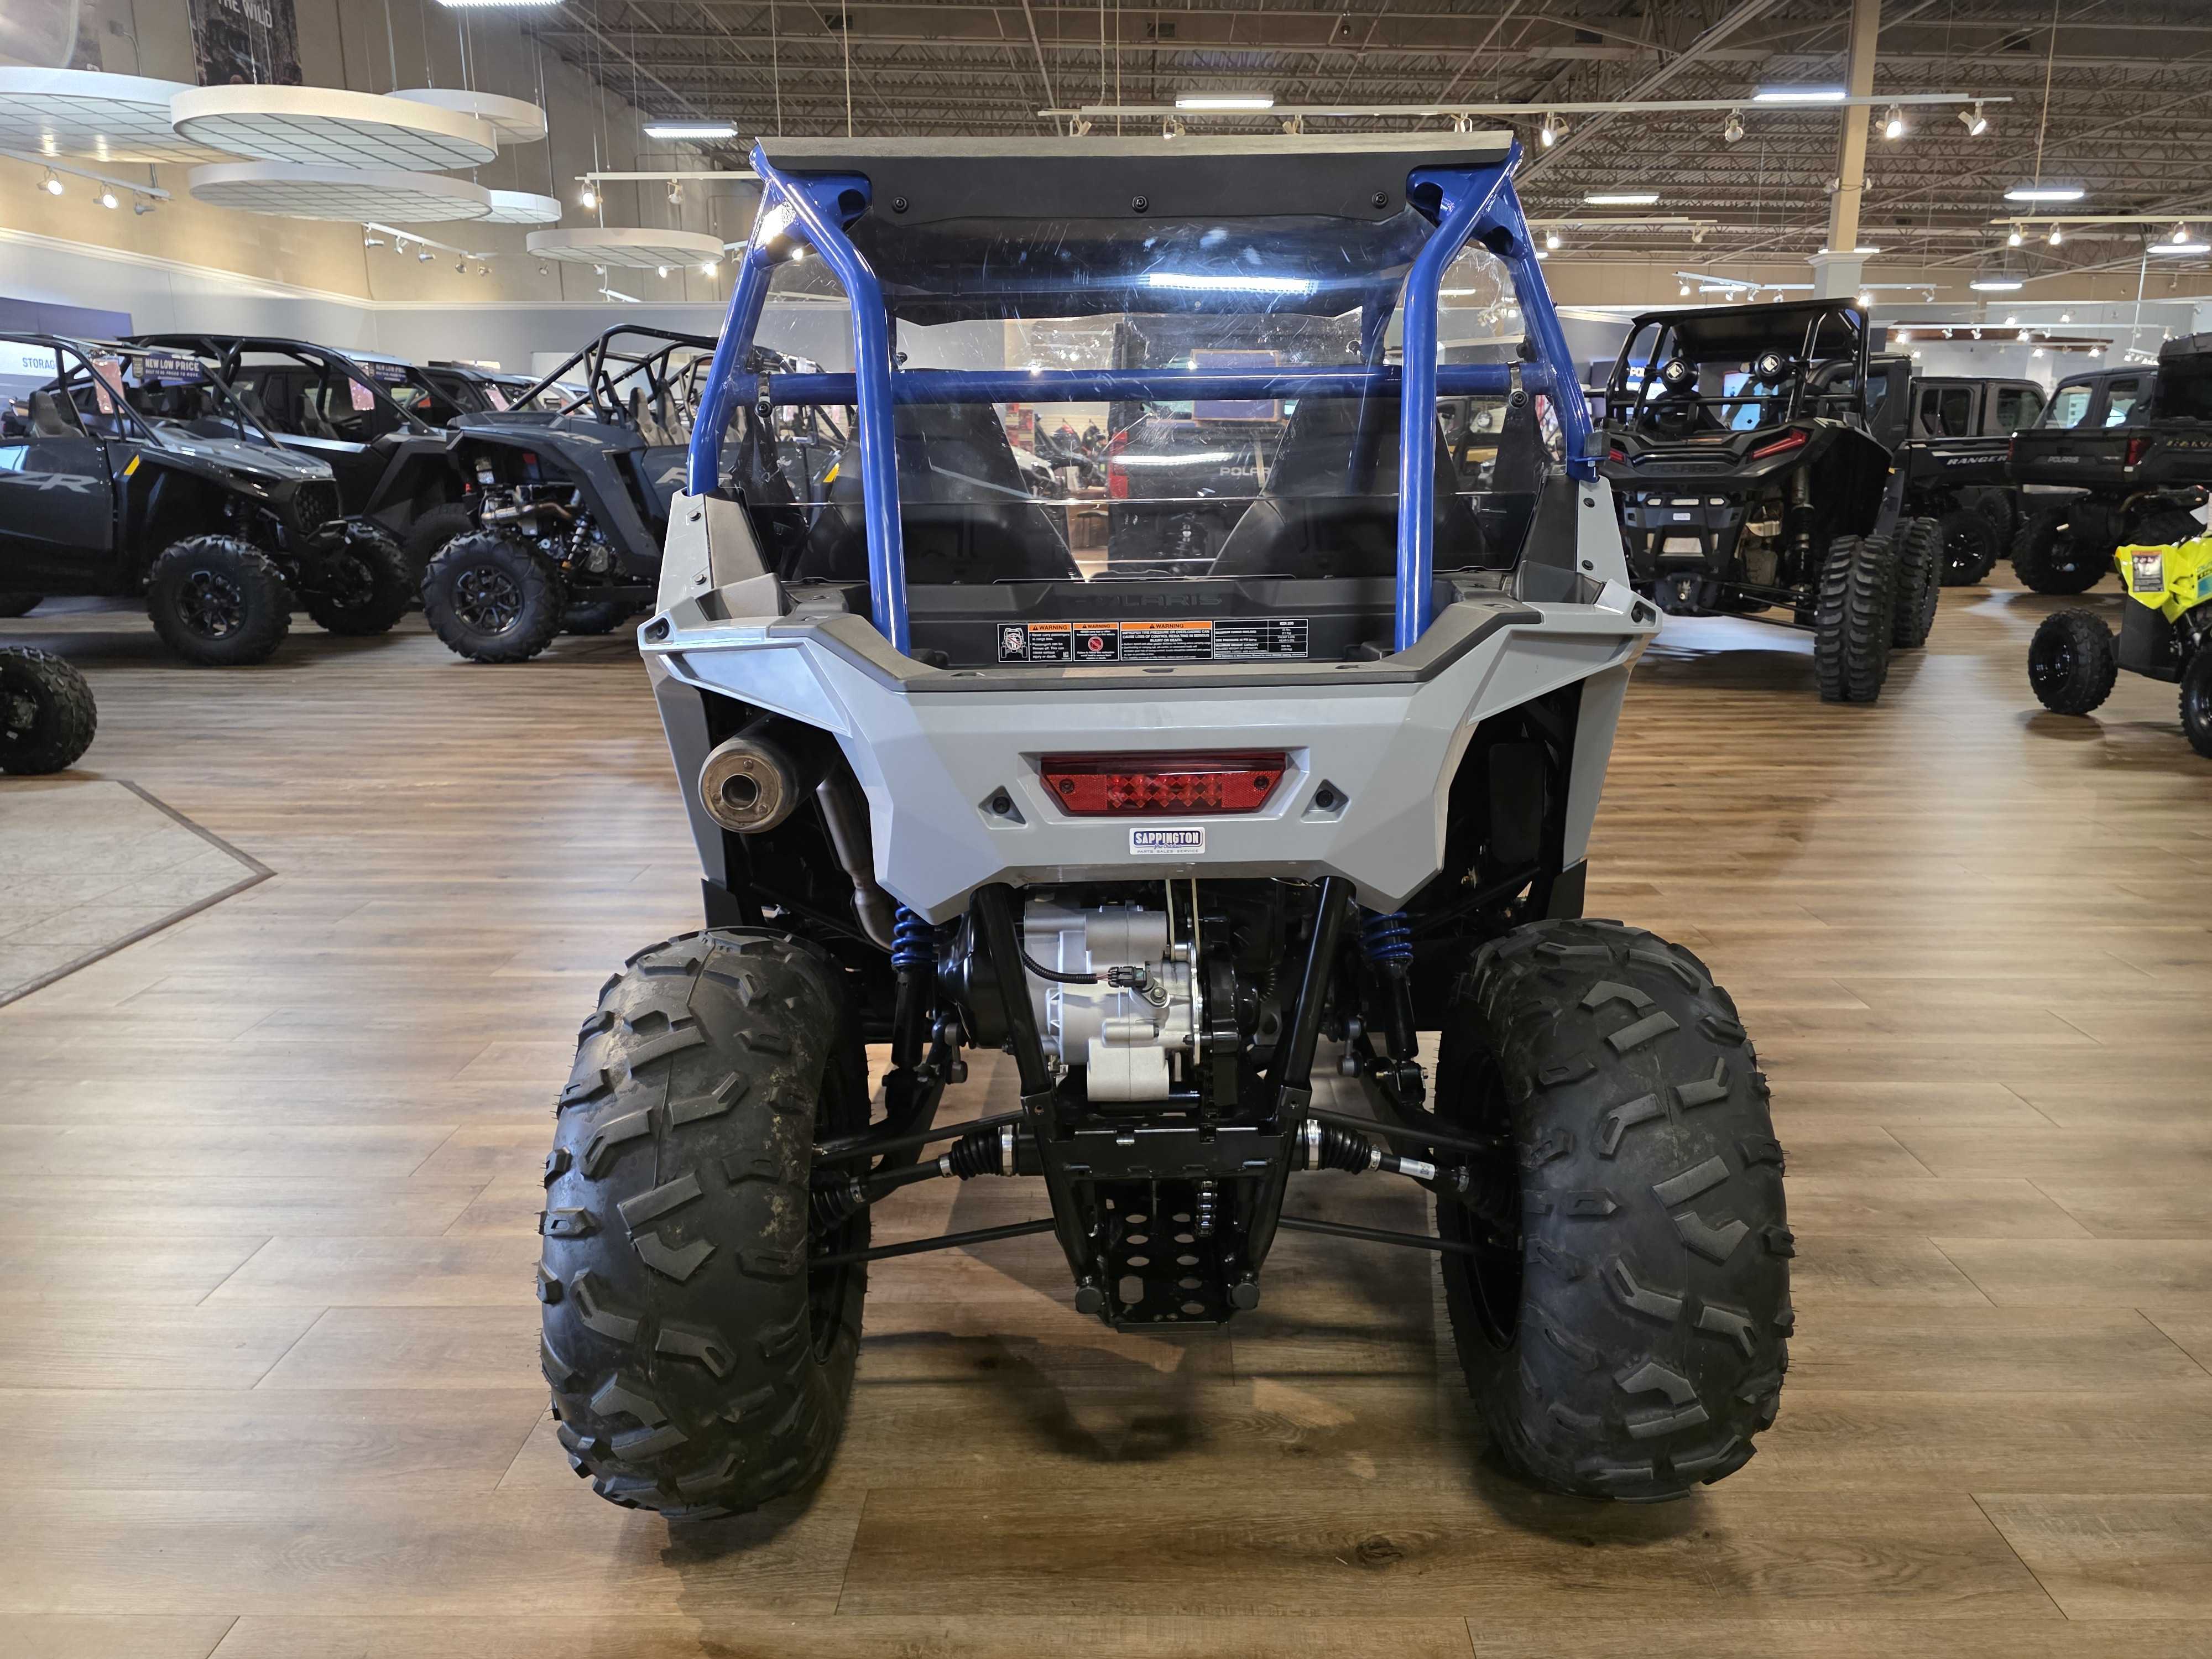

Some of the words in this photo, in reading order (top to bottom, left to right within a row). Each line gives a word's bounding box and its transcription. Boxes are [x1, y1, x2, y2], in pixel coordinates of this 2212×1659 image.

[218, 0, 241, 13] HE
[242, 0, 273, 28] WILD
[145, 358, 159, 368] NEW
[160, 359, 174, 369] LOW
[175, 361, 200, 372] PRICE
[1947, 455, 2007, 465] RANGER
[1135, 832, 1199, 844] SAPPINGTON
